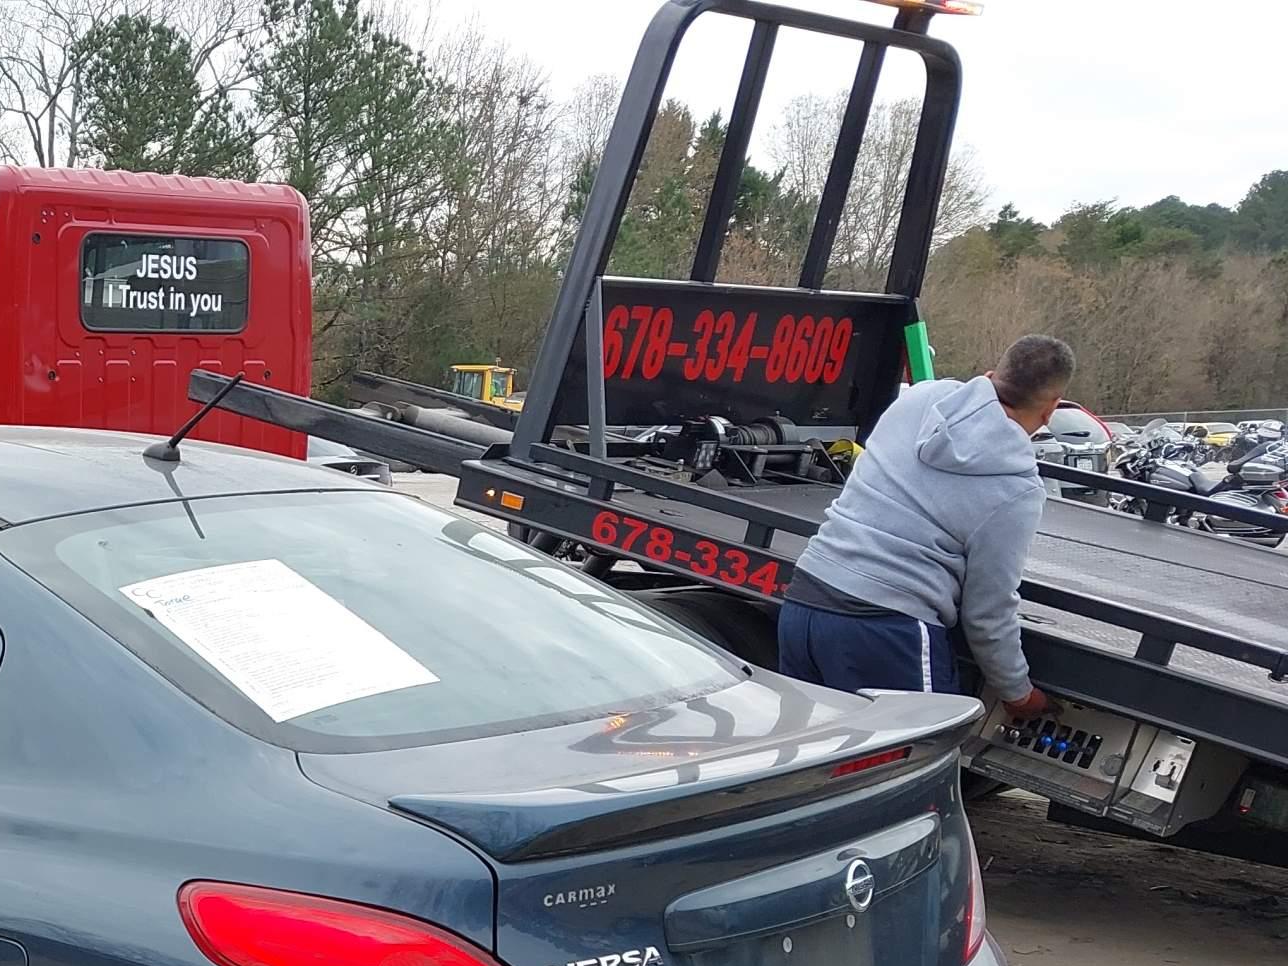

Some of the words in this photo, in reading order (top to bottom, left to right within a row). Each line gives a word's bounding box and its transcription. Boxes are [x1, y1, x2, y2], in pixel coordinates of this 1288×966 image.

[136, 253, 197, 281] JESUS
[108, 283, 113, 308] I
[119, 284, 165, 310] Trust
[169, 286, 185, 310] in
[190, 292, 222, 317] you
[604, 304, 853, 384] 678-334-8609
